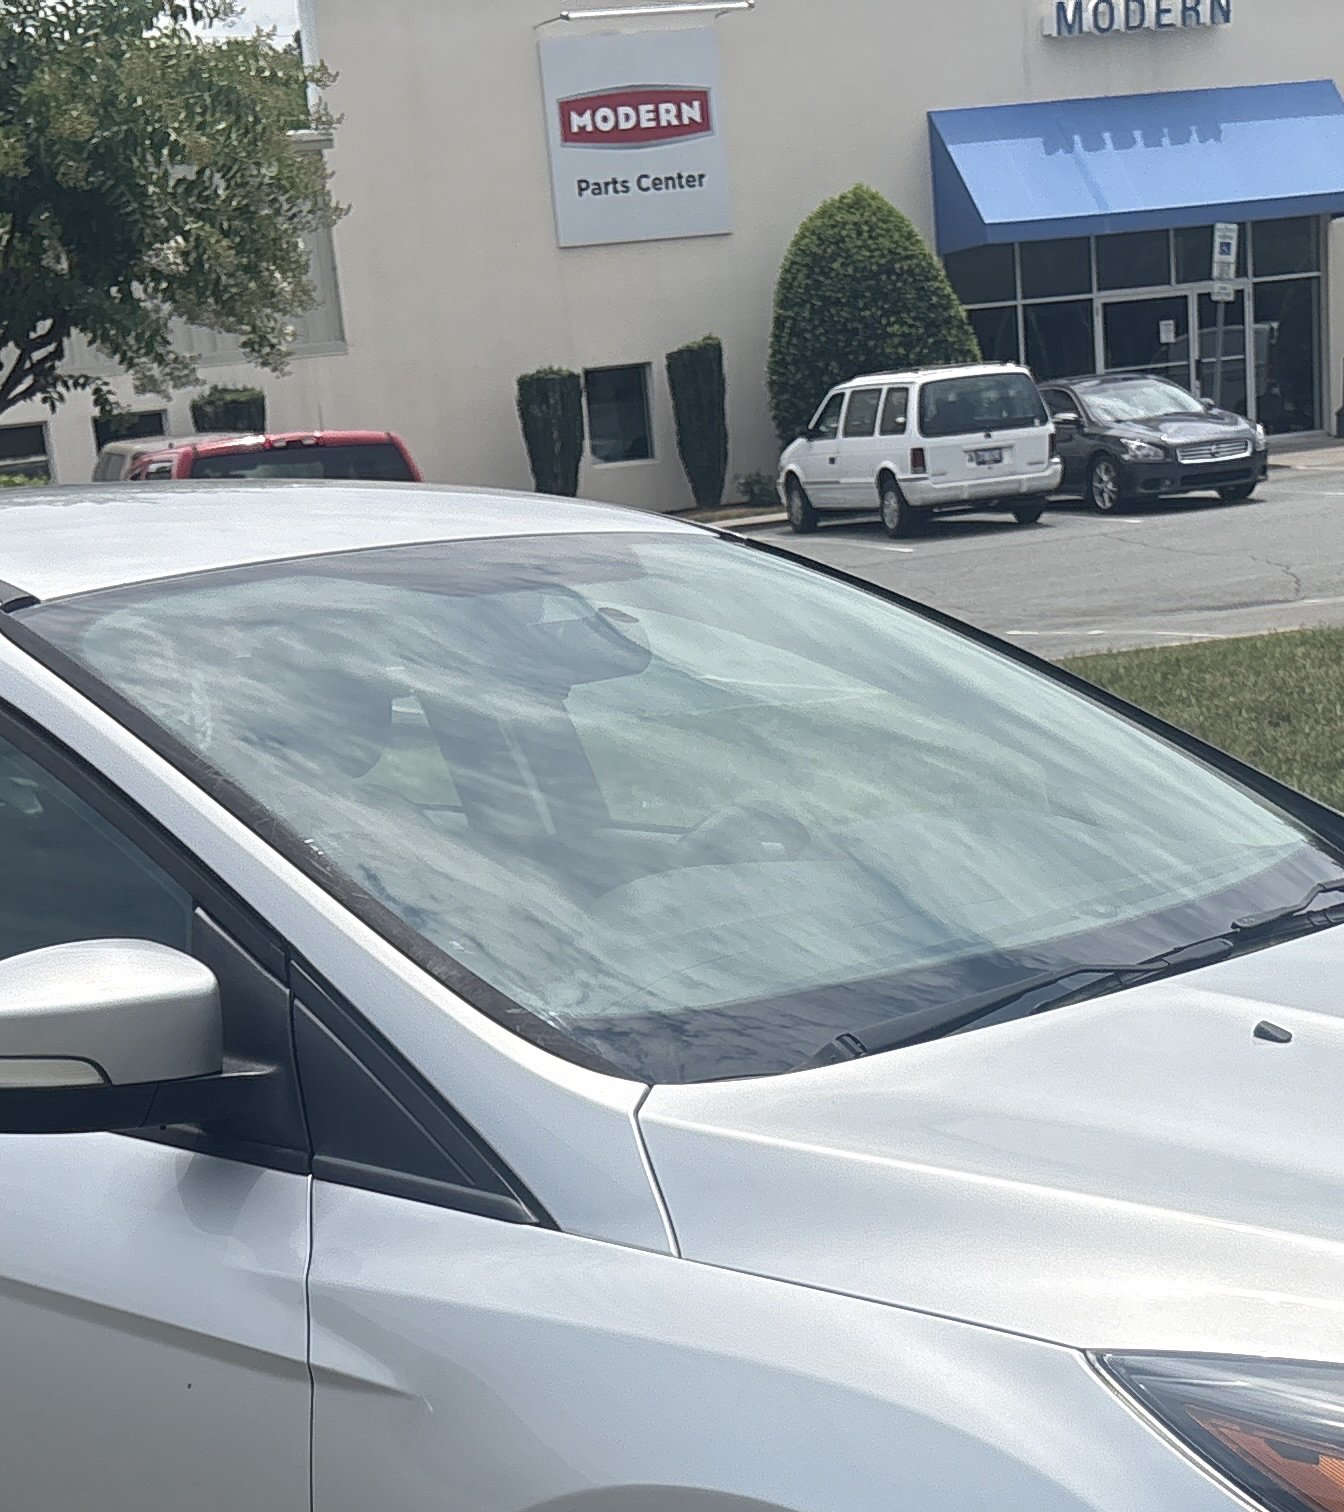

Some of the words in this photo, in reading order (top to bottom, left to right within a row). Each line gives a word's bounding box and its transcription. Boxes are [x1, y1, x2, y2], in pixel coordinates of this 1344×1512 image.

[1056, 0, 1232, 35] MODERN
[569, 100, 703, 133] MODERN
[576, 176, 631, 198] Parts
[636, 171, 706, 193] Center
